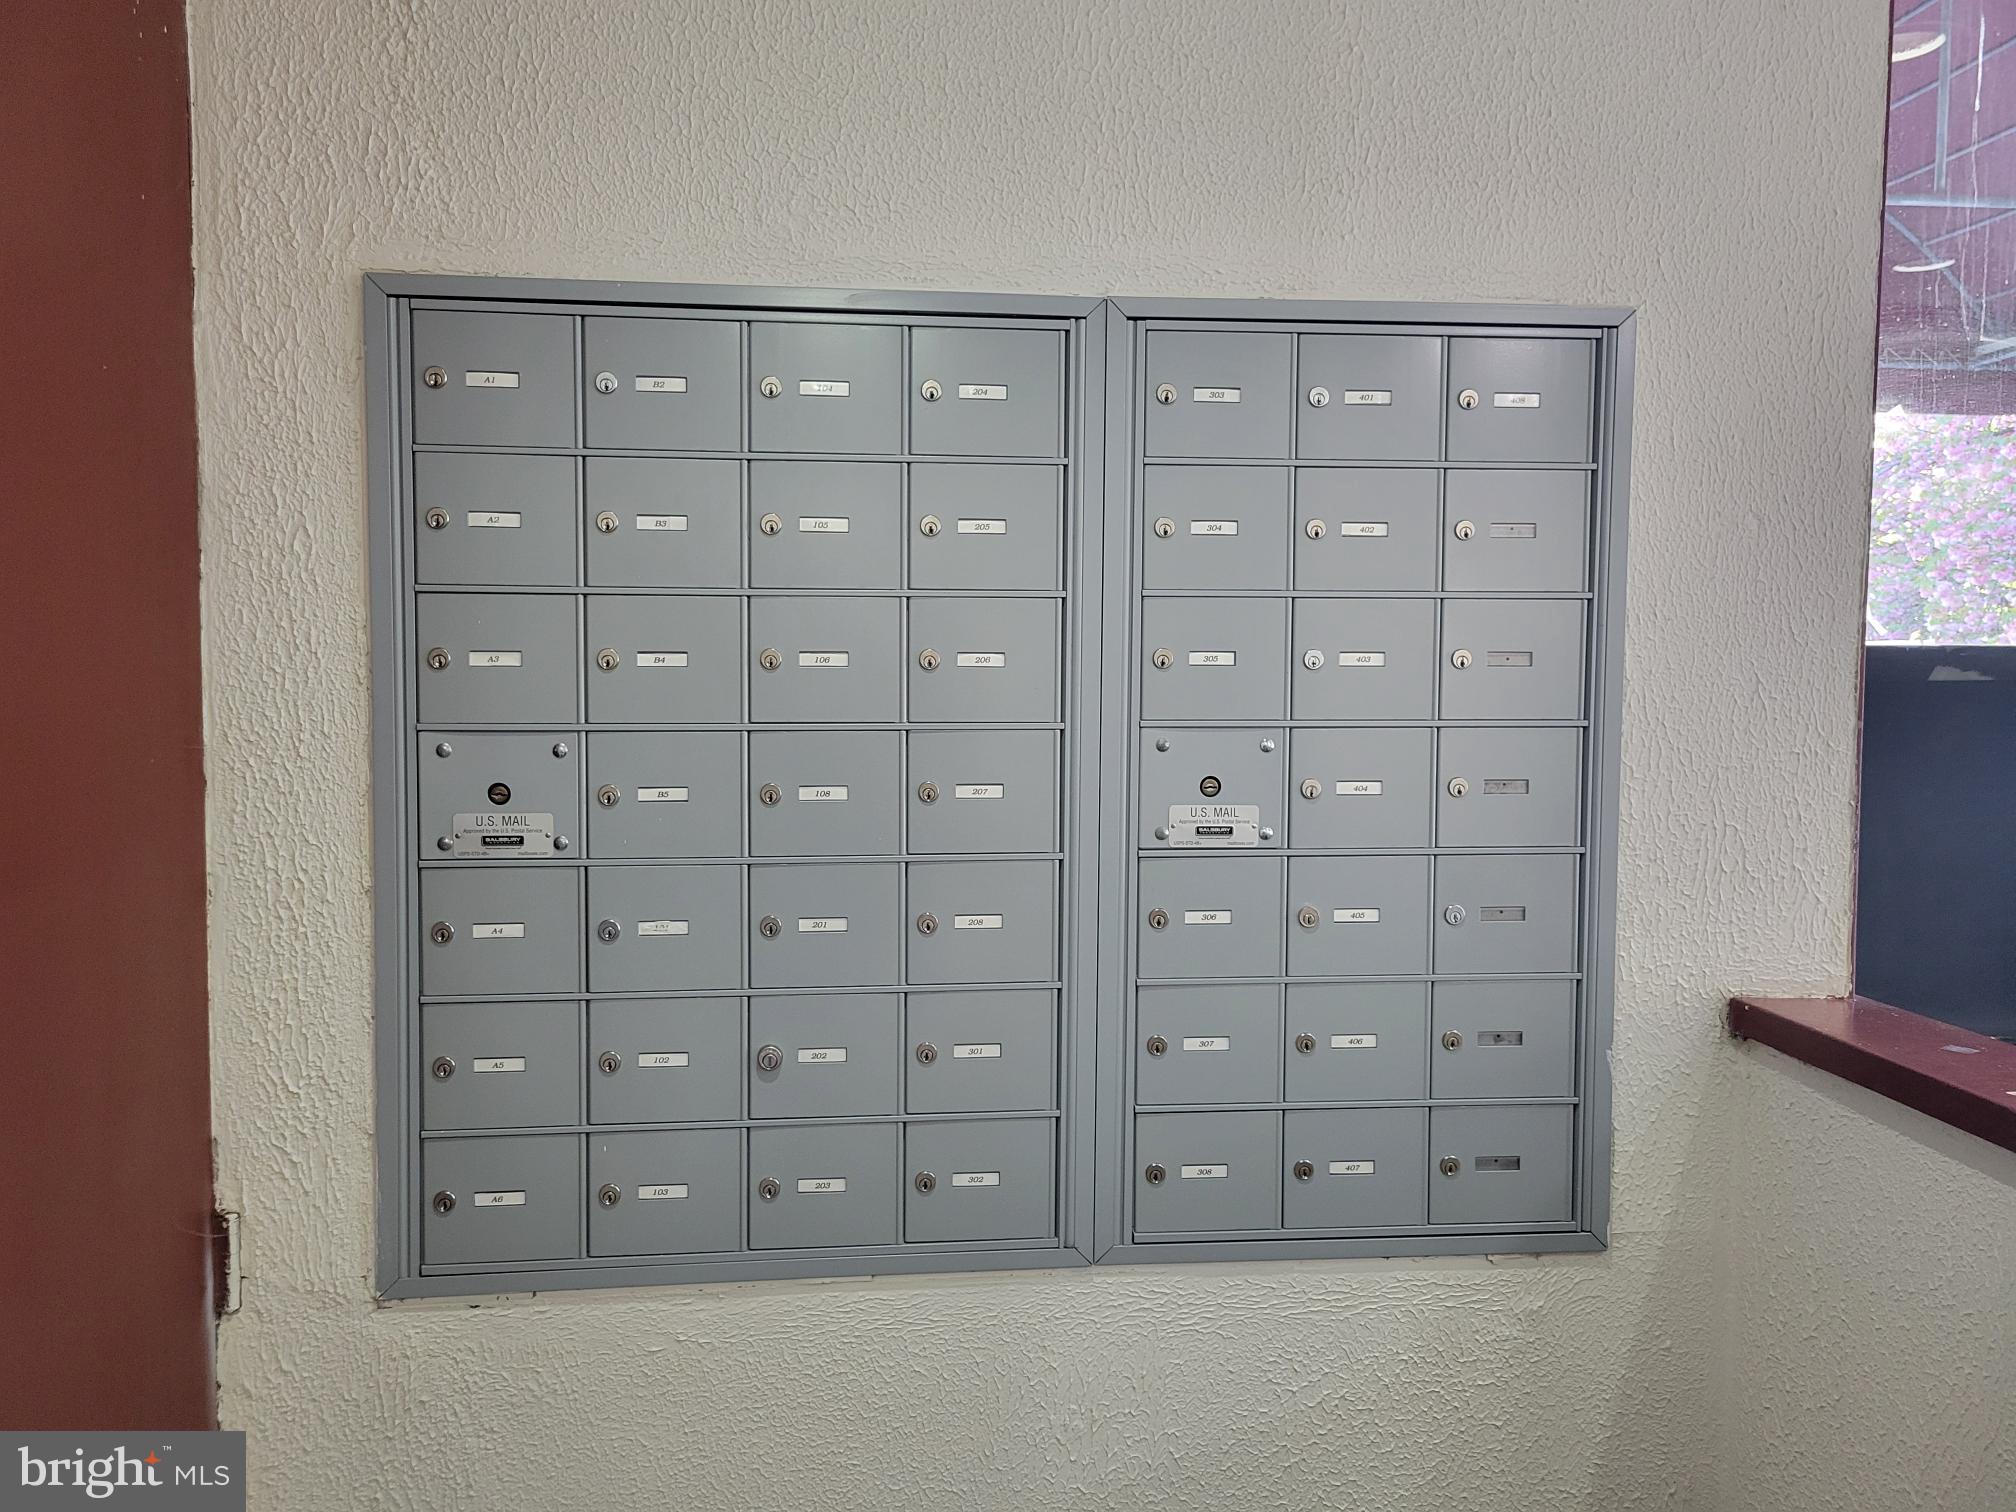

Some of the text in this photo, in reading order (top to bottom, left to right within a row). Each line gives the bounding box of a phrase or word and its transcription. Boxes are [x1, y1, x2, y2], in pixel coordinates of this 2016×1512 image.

[483, 376, 496, 384] A1
[652, 380, 665, 389] B2
[971, 388, 989, 397] 204
[1208, 391, 1225, 399] 303
[1358, 394, 1374, 402] 401
[486, 516, 500, 524] A2
[654, 520, 668, 528] B3
[812, 521, 829, 529] 105
[973, 523, 991, 531] 205
[1206, 524, 1223, 532] 304
[1359, 526, 1375, 534] 402
[487, 655, 500, 663] A3
[653, 656, 666, 664] B4
[814, 656, 831, 664] 106
[974, 656, 991, 664] 206
[1202, 655, 1219, 663] 305
[1355, 655, 1372, 663] 403
[656, 790, 670, 798] B5
[814, 790, 832, 798] 108
[971, 788, 989, 796] 207
[1190, 807, 1240, 818] U.S. MAIL
[475, 815, 531, 827] U.S. MAIL
[1200, 913, 1217, 921] 306
[1349, 912, 1366, 920] 405
[811, 921, 828, 929] 201
[967, 918, 984, 926] 208
[490, 927, 504, 935] A4
[1198, 1040, 1215, 1048] 307
[1347, 1038, 1364, 1046] 406
[967, 1047, 984, 1056] 301
[653, 1056, 670, 1064] 102
[810, 1052, 828, 1060] 202
[491, 1061, 505, 1069] A5
[1196, 1168, 1213, 1176] 308
[1344, 1164, 1361, 1172] 407
[967, 1176, 985, 1184] 302
[814, 1182, 831, 1190] 203
[652, 1188, 669, 1196] 103
[490, 1195, 504, 1204] A6
